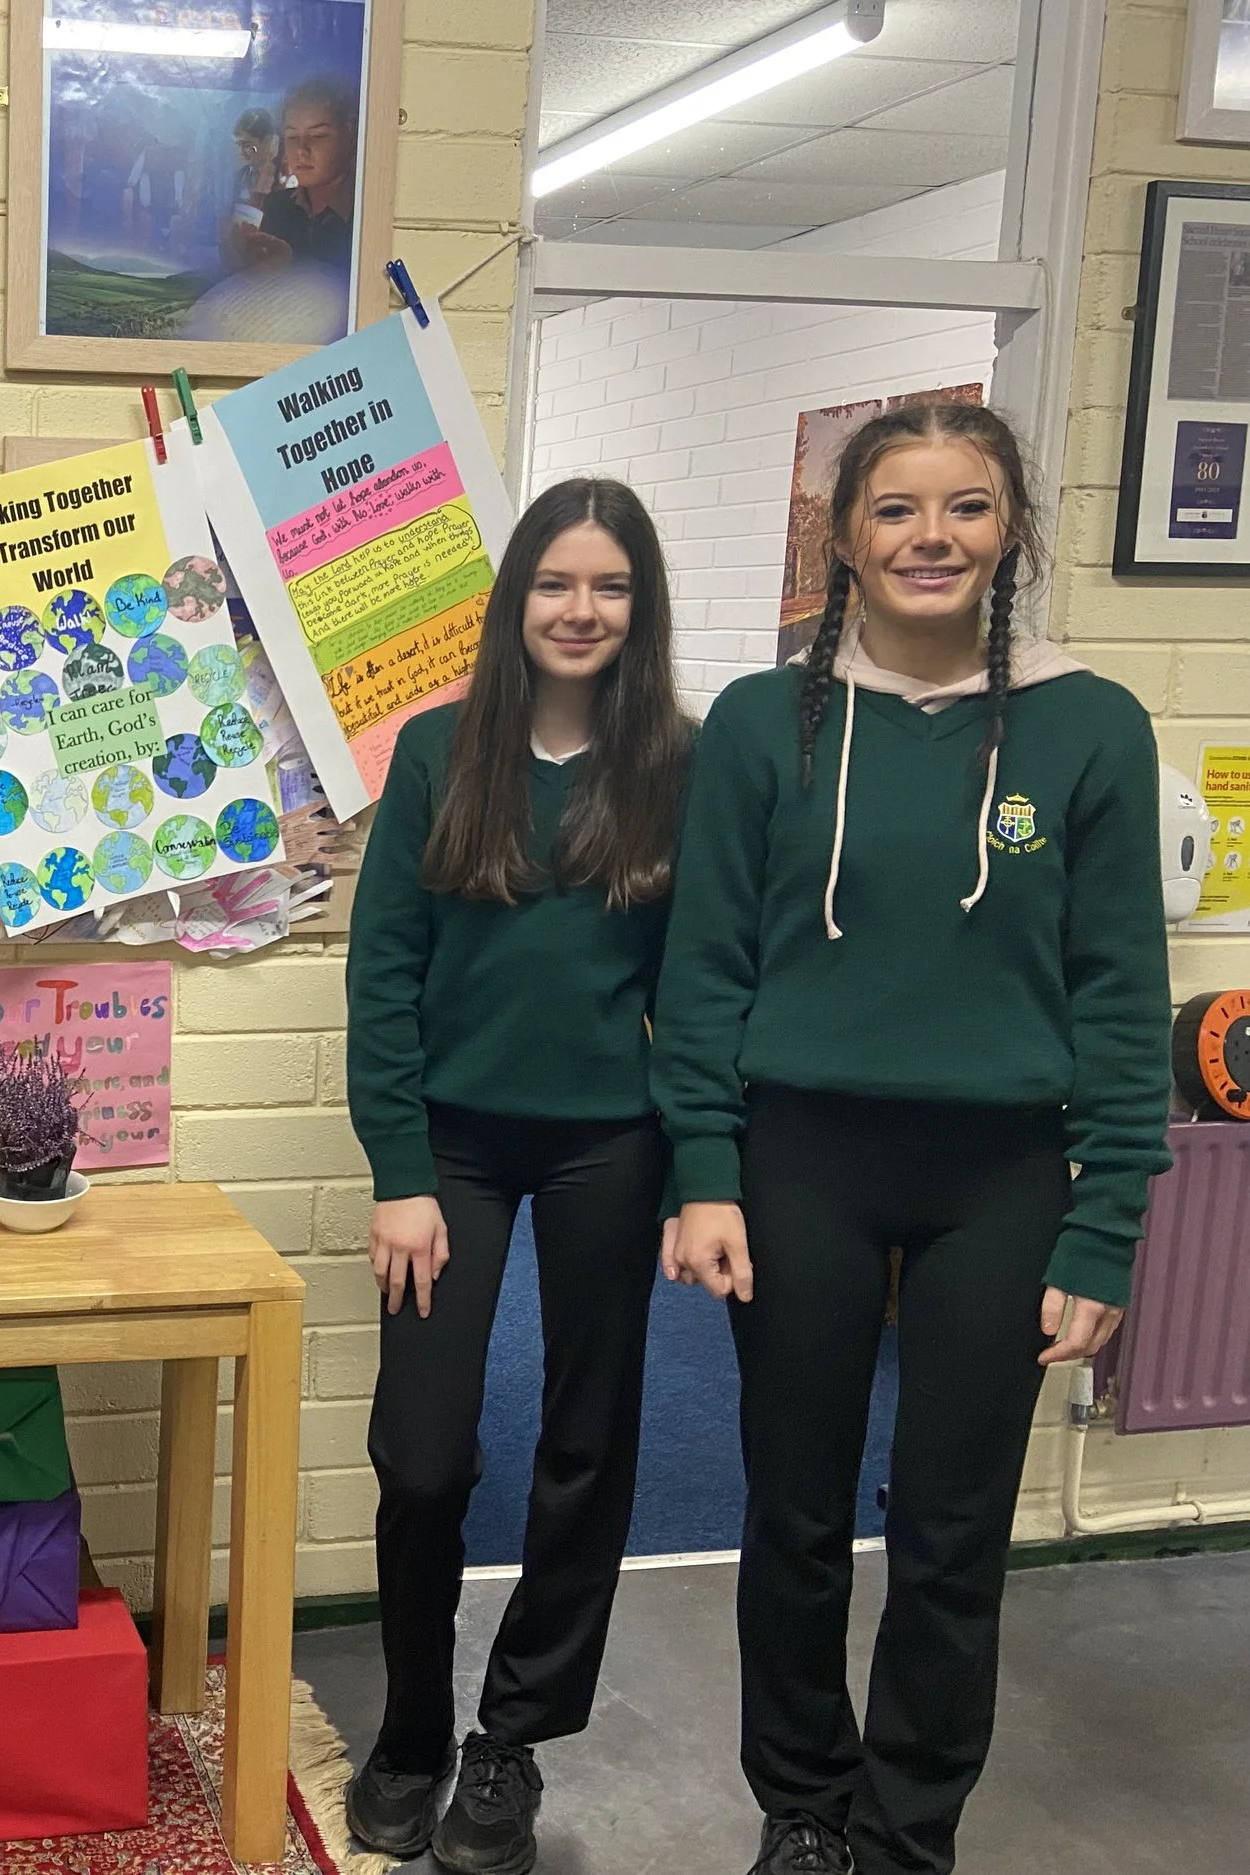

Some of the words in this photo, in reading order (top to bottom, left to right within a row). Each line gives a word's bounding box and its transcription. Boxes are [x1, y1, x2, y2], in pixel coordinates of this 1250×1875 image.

[277, 367, 364, 423] Walking
[277, 409, 368, 470] Together
[368, 398, 393, 424] in
[320, 454, 375, 493] Hope
[1197, 462, 1220, 480] 80
[44, 475, 132, 513] Together
[271, 531, 288, 546] We
[290, 518, 314, 538] must
[315, 507, 330, 524] not
[333, 499, 346, 514] let
[349, 487, 372, 506] hope
[373, 466, 409, 492] abandon
[332, 515, 351, 534] with
[395, 482, 421, 500] walks
[422, 468, 446, 485] with
[103, 513, 136, 538] our
[292, 583, 313, 599] May
[314, 572, 329, 584] the
[331, 560, 352, 576] Lord
[372, 545, 382, 553] us
[383, 538, 395, 548] to
[399, 514, 449, 543] understand
[32, 559, 93, 592] World
[115, 598, 134, 612] Be
[136, 592, 162, 607] Kind
[56, 608, 91, 632] Walk
[48, 711, 56, 726] I
[60, 710, 87, 723] can
[92, 698, 125, 714] care
[129, 690, 153, 706] for
[217, 714, 249, 728] Reduce
[56, 727, 105, 750] Earth,
[222, 743, 256, 757] Recycle
[64, 751, 133, 776] creation,
[136, 739, 160, 758] by:
[1207, 769, 1228, 779] How
[1230, 770, 1240, 779] to
[1206, 781, 1228, 790] hand
[1230, 781, 1250, 790] sani
[1009, 846, 1020, 854] na
[36, 980, 168, 1025] Troubles
